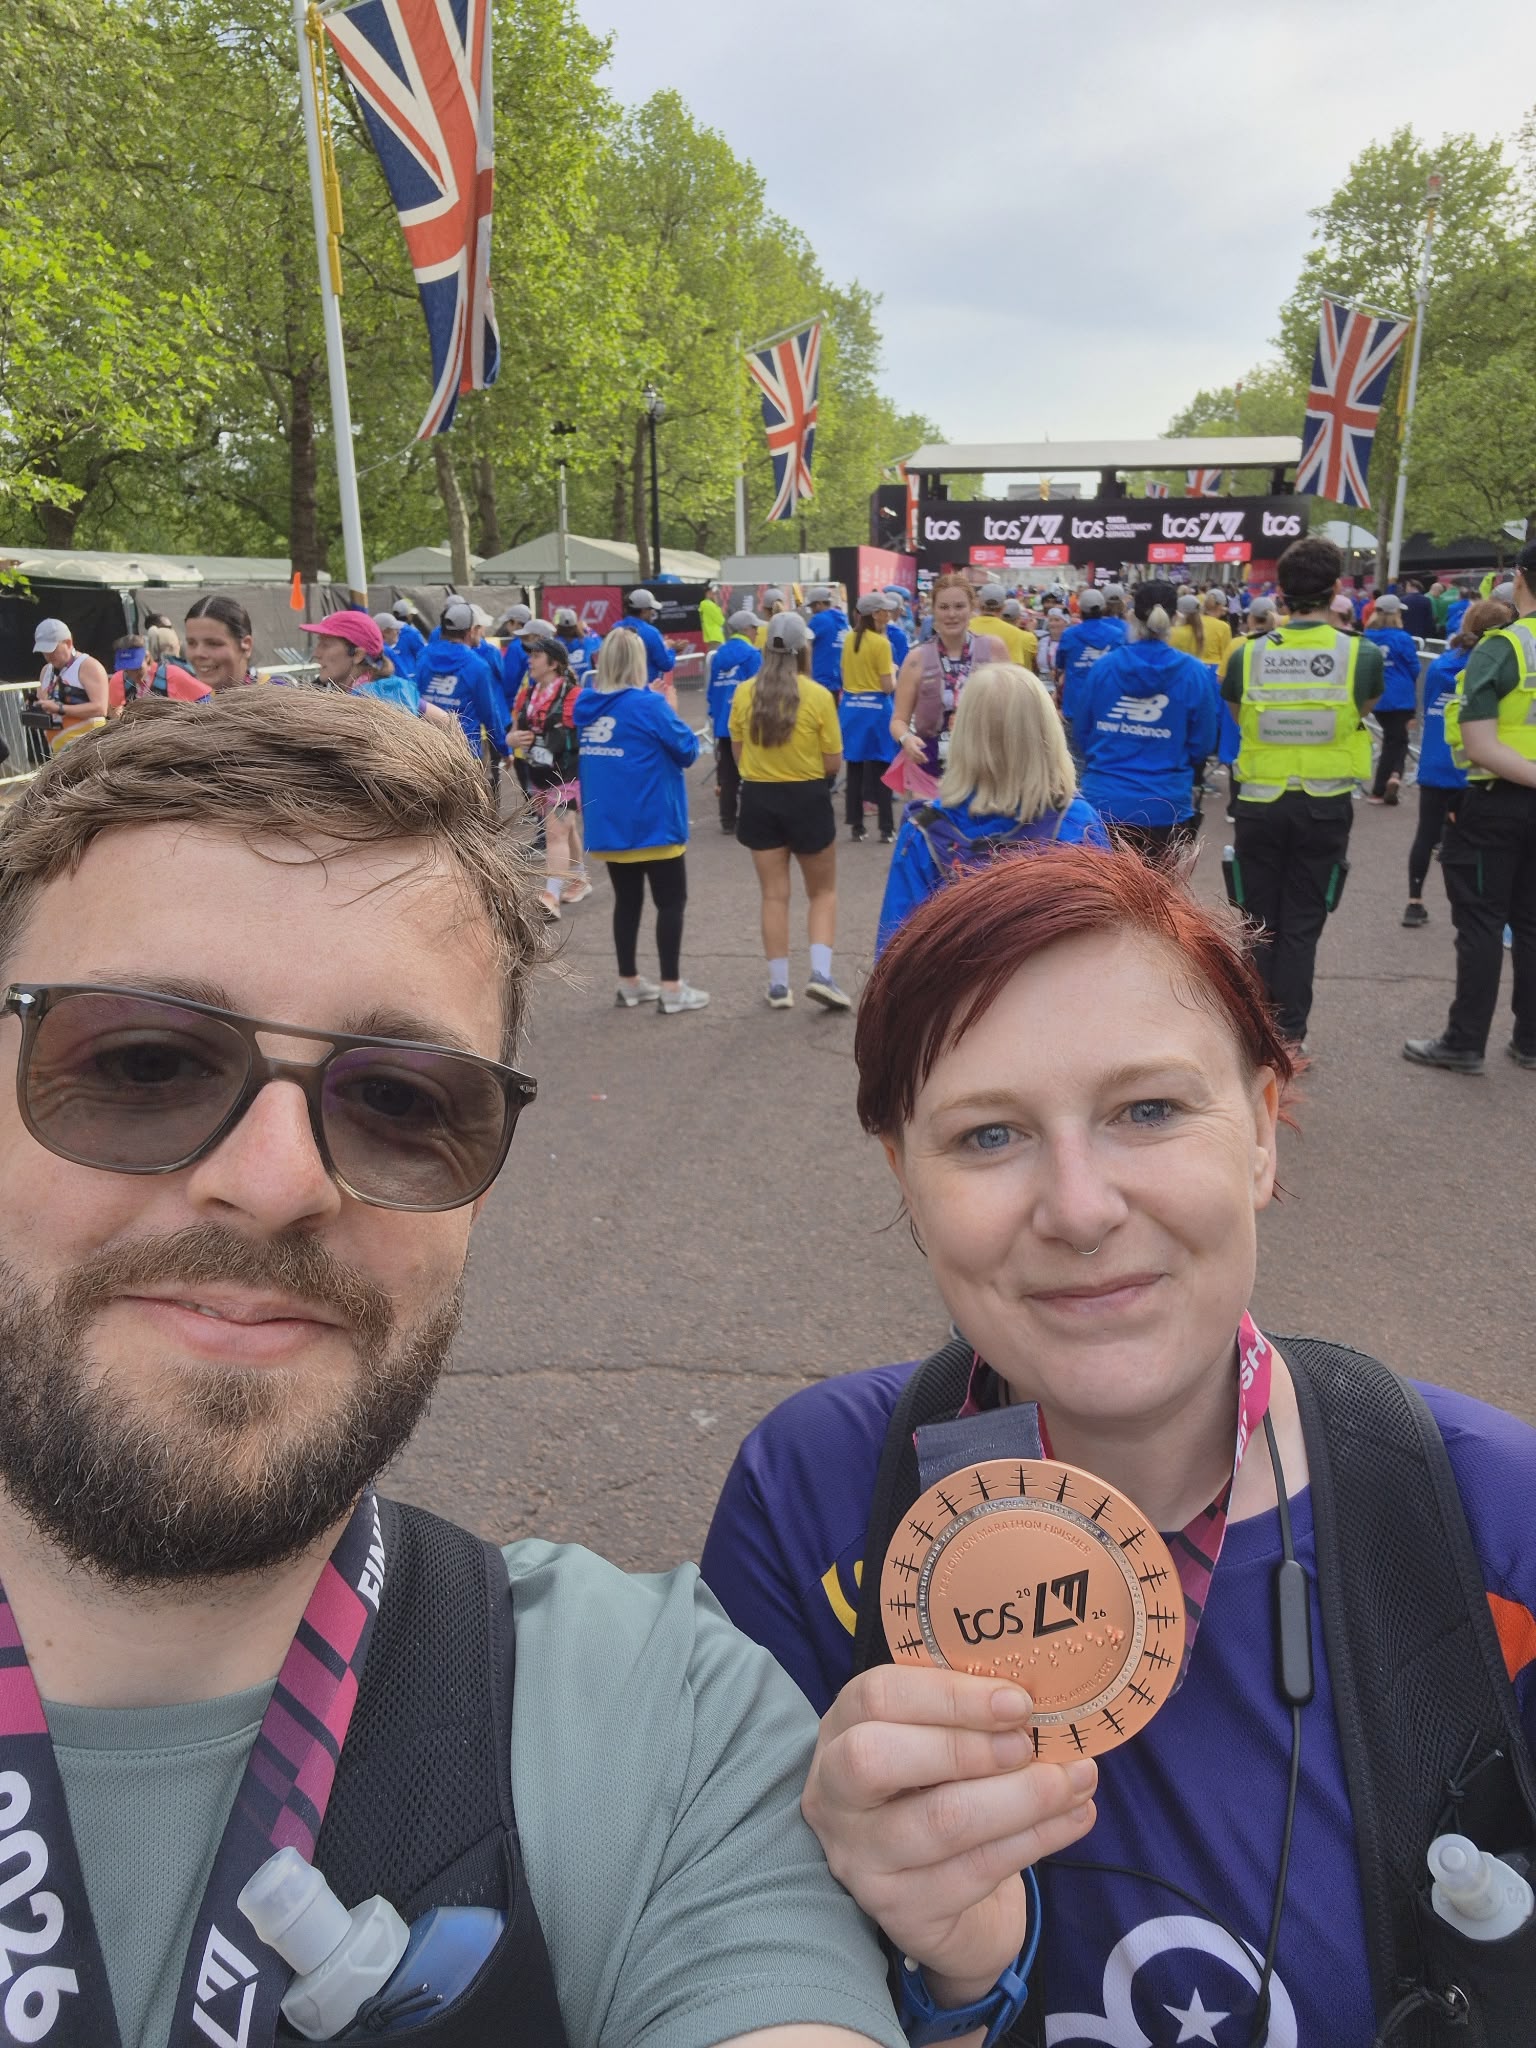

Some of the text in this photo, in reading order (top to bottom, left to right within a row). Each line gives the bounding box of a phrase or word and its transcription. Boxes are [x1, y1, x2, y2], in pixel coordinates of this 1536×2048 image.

[924, 516, 961, 540] tcs
[984, 516, 1021, 540] tcs
[1071, 516, 1104, 538] tcs
[1162, 512, 1200, 538] tcs
[1262, 510, 1301, 536] tcs
[1264, 656, 1307, 668] St John
[1096, 721, 1172, 739] new balance
[943, 1534, 978, 1575] LONDON
[974, 1519, 1042, 1541] MARATHON
[1043, 1522, 1092, 1556] FINISHER
[953, 1601, 1024, 1645] tcs
[1016, 1587, 1031, 1599] 20
[1092, 1609, 1107, 1620] 26
[1067, 1678, 1097, 1700] APRIL
